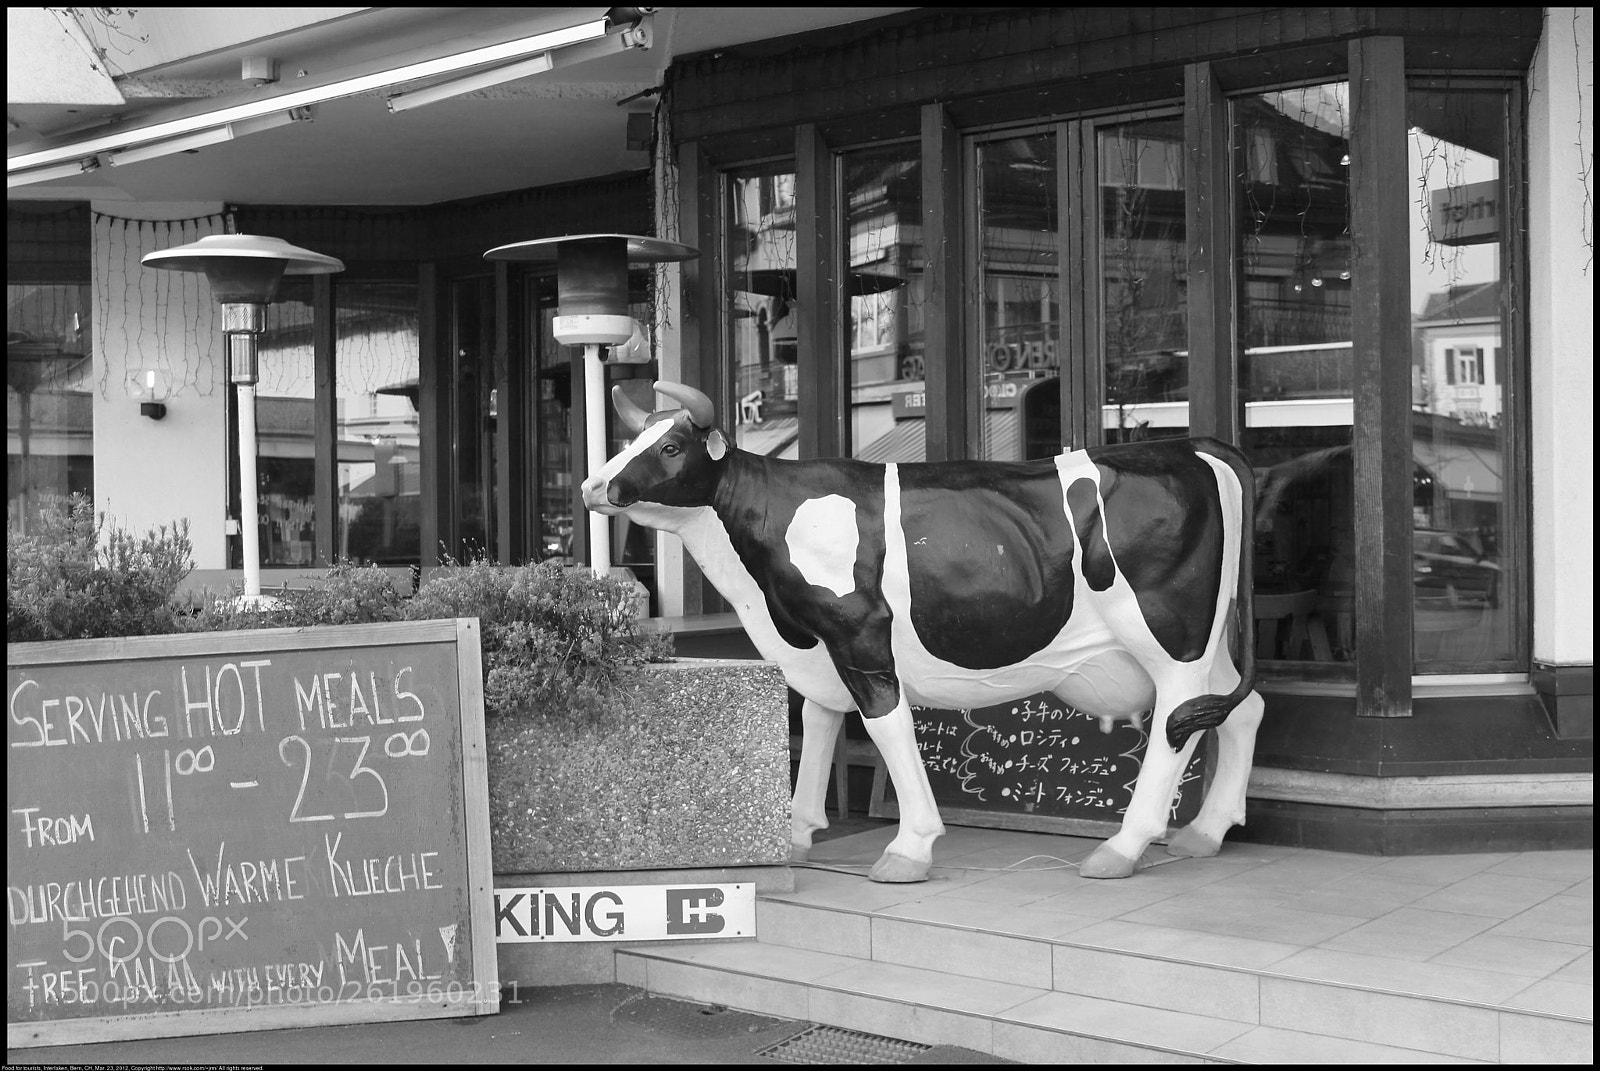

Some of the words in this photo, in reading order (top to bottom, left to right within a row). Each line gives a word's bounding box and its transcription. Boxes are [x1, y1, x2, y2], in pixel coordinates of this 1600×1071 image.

[11, 680, 168, 747] SERVING
[182, 660, 271, 738] HOT
[295, 667, 424, 731] MEALS
[1016, 754, 1053, 772] チーズ
[12, 807, 95, 848] FROM
[7, 871, 186, 925] DURCHGEHEND
[187, 841, 305, 907] WARME
[325, 832, 443, 897] KUECHE
[495, 891, 625, 937] KING
[211, 967, 259, 993] WITH
[265, 960, 324, 991] EVERY
